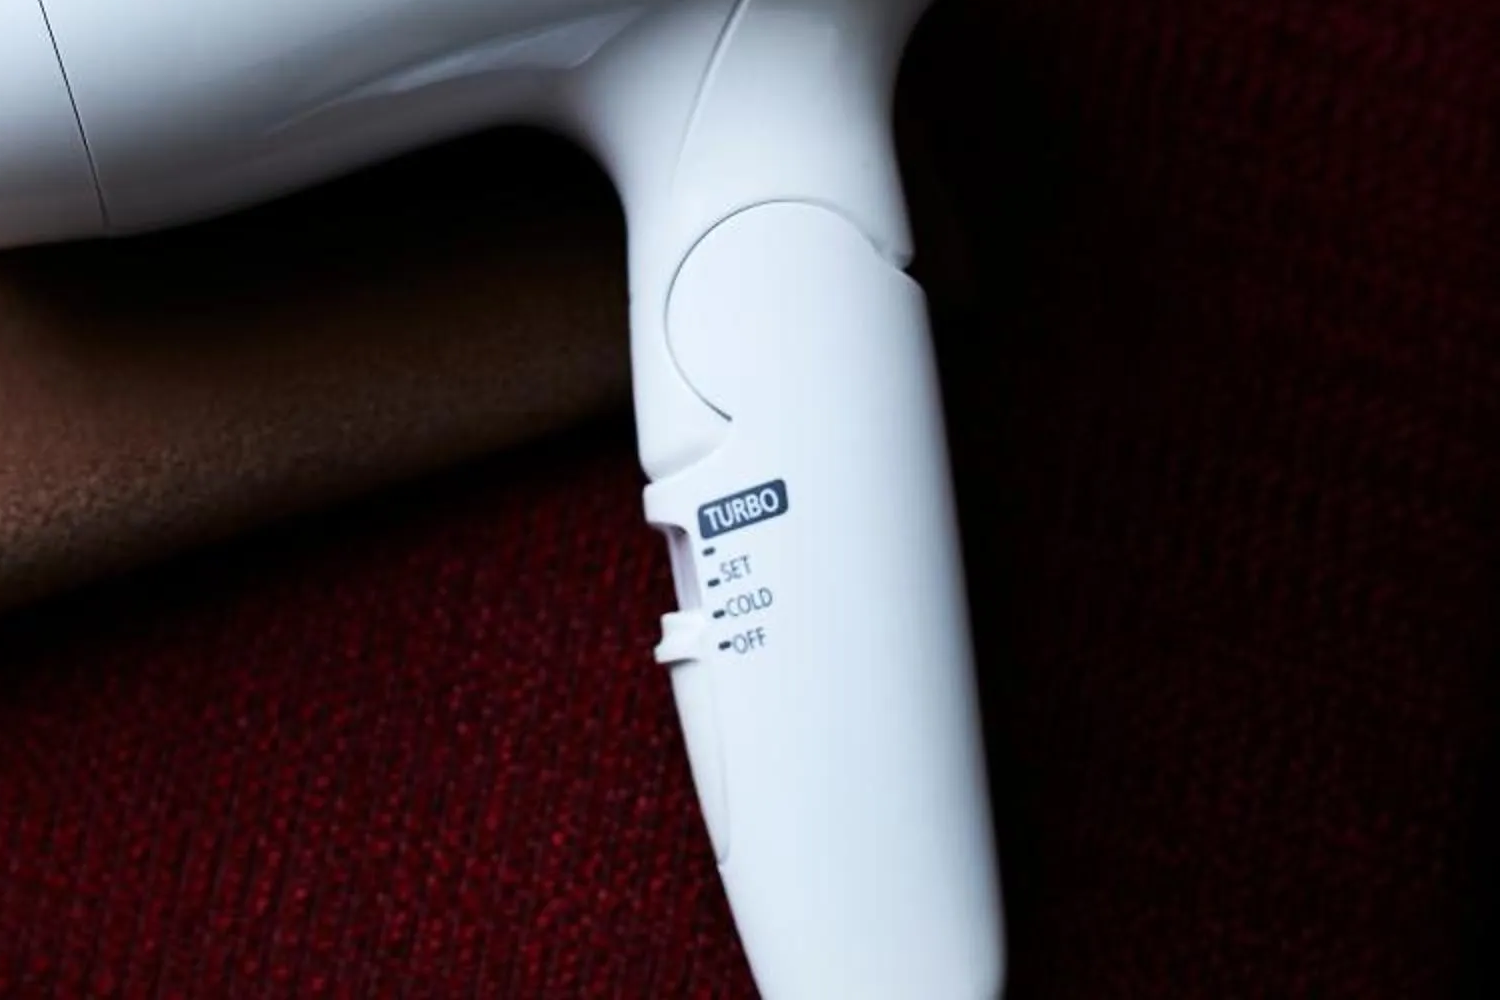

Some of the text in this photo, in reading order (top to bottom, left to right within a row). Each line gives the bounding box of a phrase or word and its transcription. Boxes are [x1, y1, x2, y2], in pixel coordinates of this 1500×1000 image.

[703, 487, 779, 531] TURBO
[719, 555, 752, 582] SET
[725, 587, 773, 617] COLD
[731, 626, 767, 654] OFF
